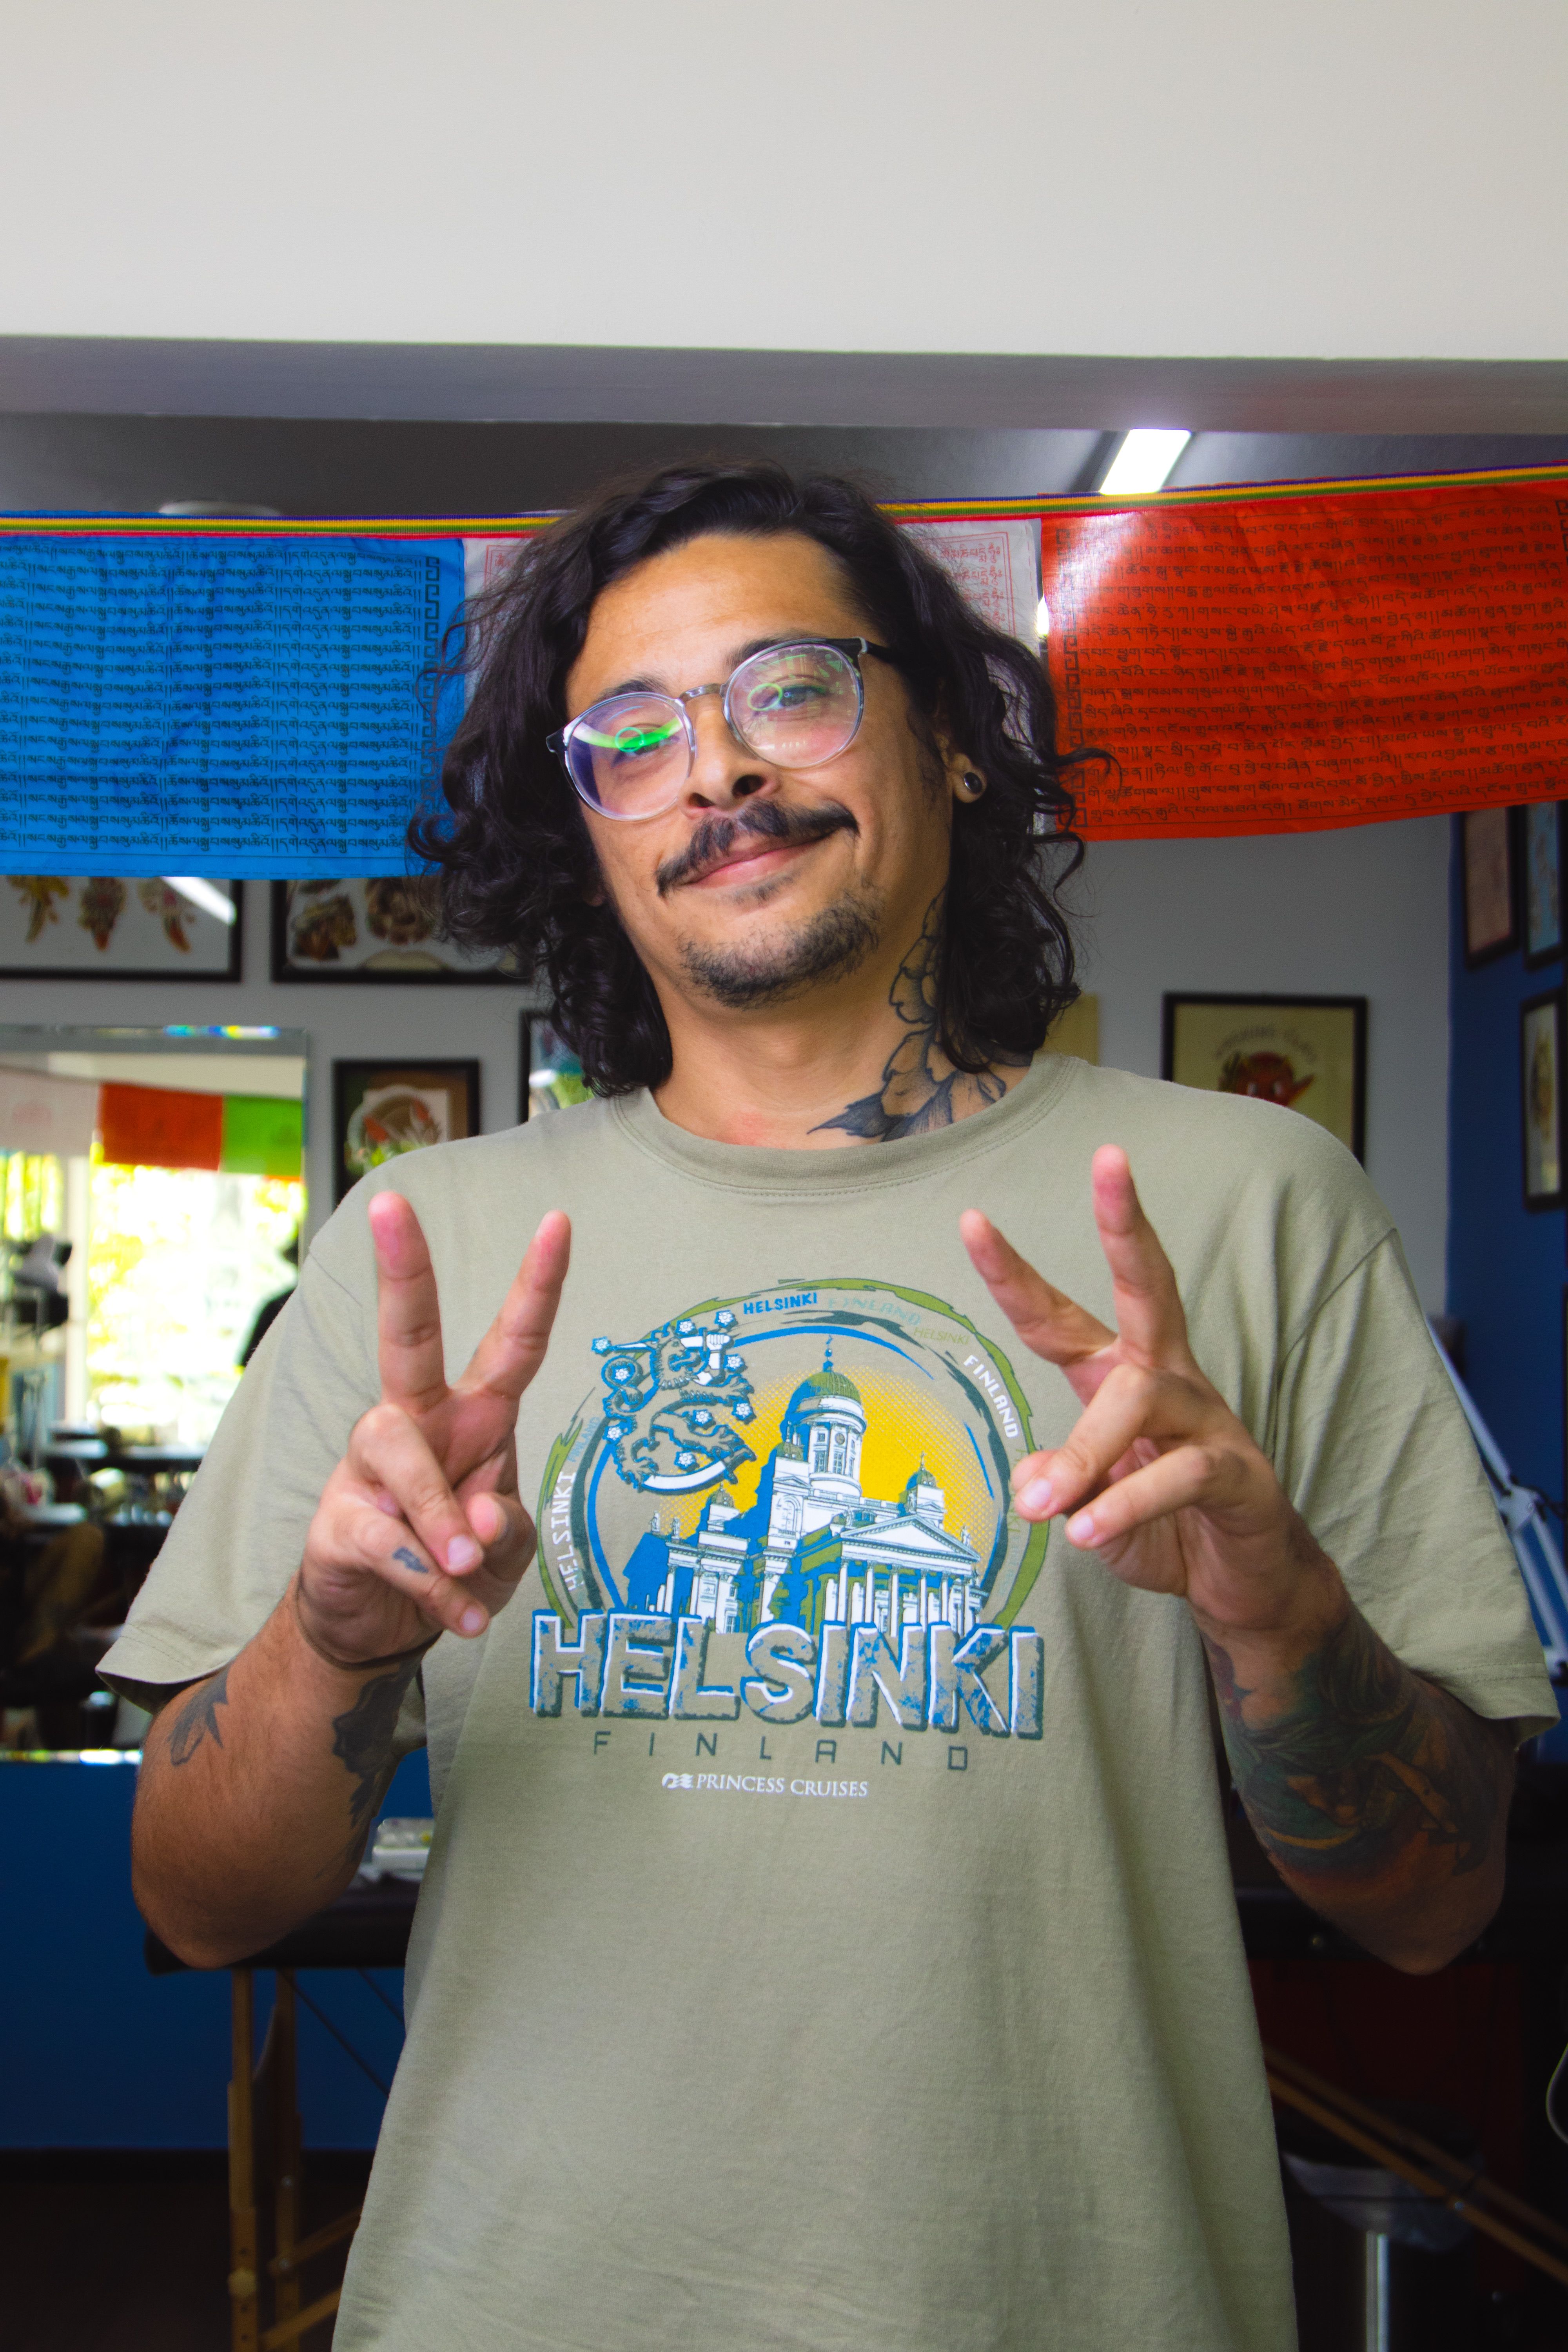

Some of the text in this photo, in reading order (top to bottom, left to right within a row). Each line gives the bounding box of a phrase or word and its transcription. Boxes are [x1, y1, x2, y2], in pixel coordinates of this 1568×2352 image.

[743, 1292, 818, 1314] HELSINKI
[828, 1297, 922, 1326] FINLAND
[913, 1327, 971, 1345] HELSINKI
[963, 1354, 1018, 1438] FINLAND
[566, 1417, 601, 1463] FINLAND
[550, 1471, 584, 1592] HELSINKI
[530, 1608, 1045, 1740] HELSINKI
[593, 1730, 968, 1771] FINLAND
[696, 1773, 868, 1797] PRINCESS CRUISES
